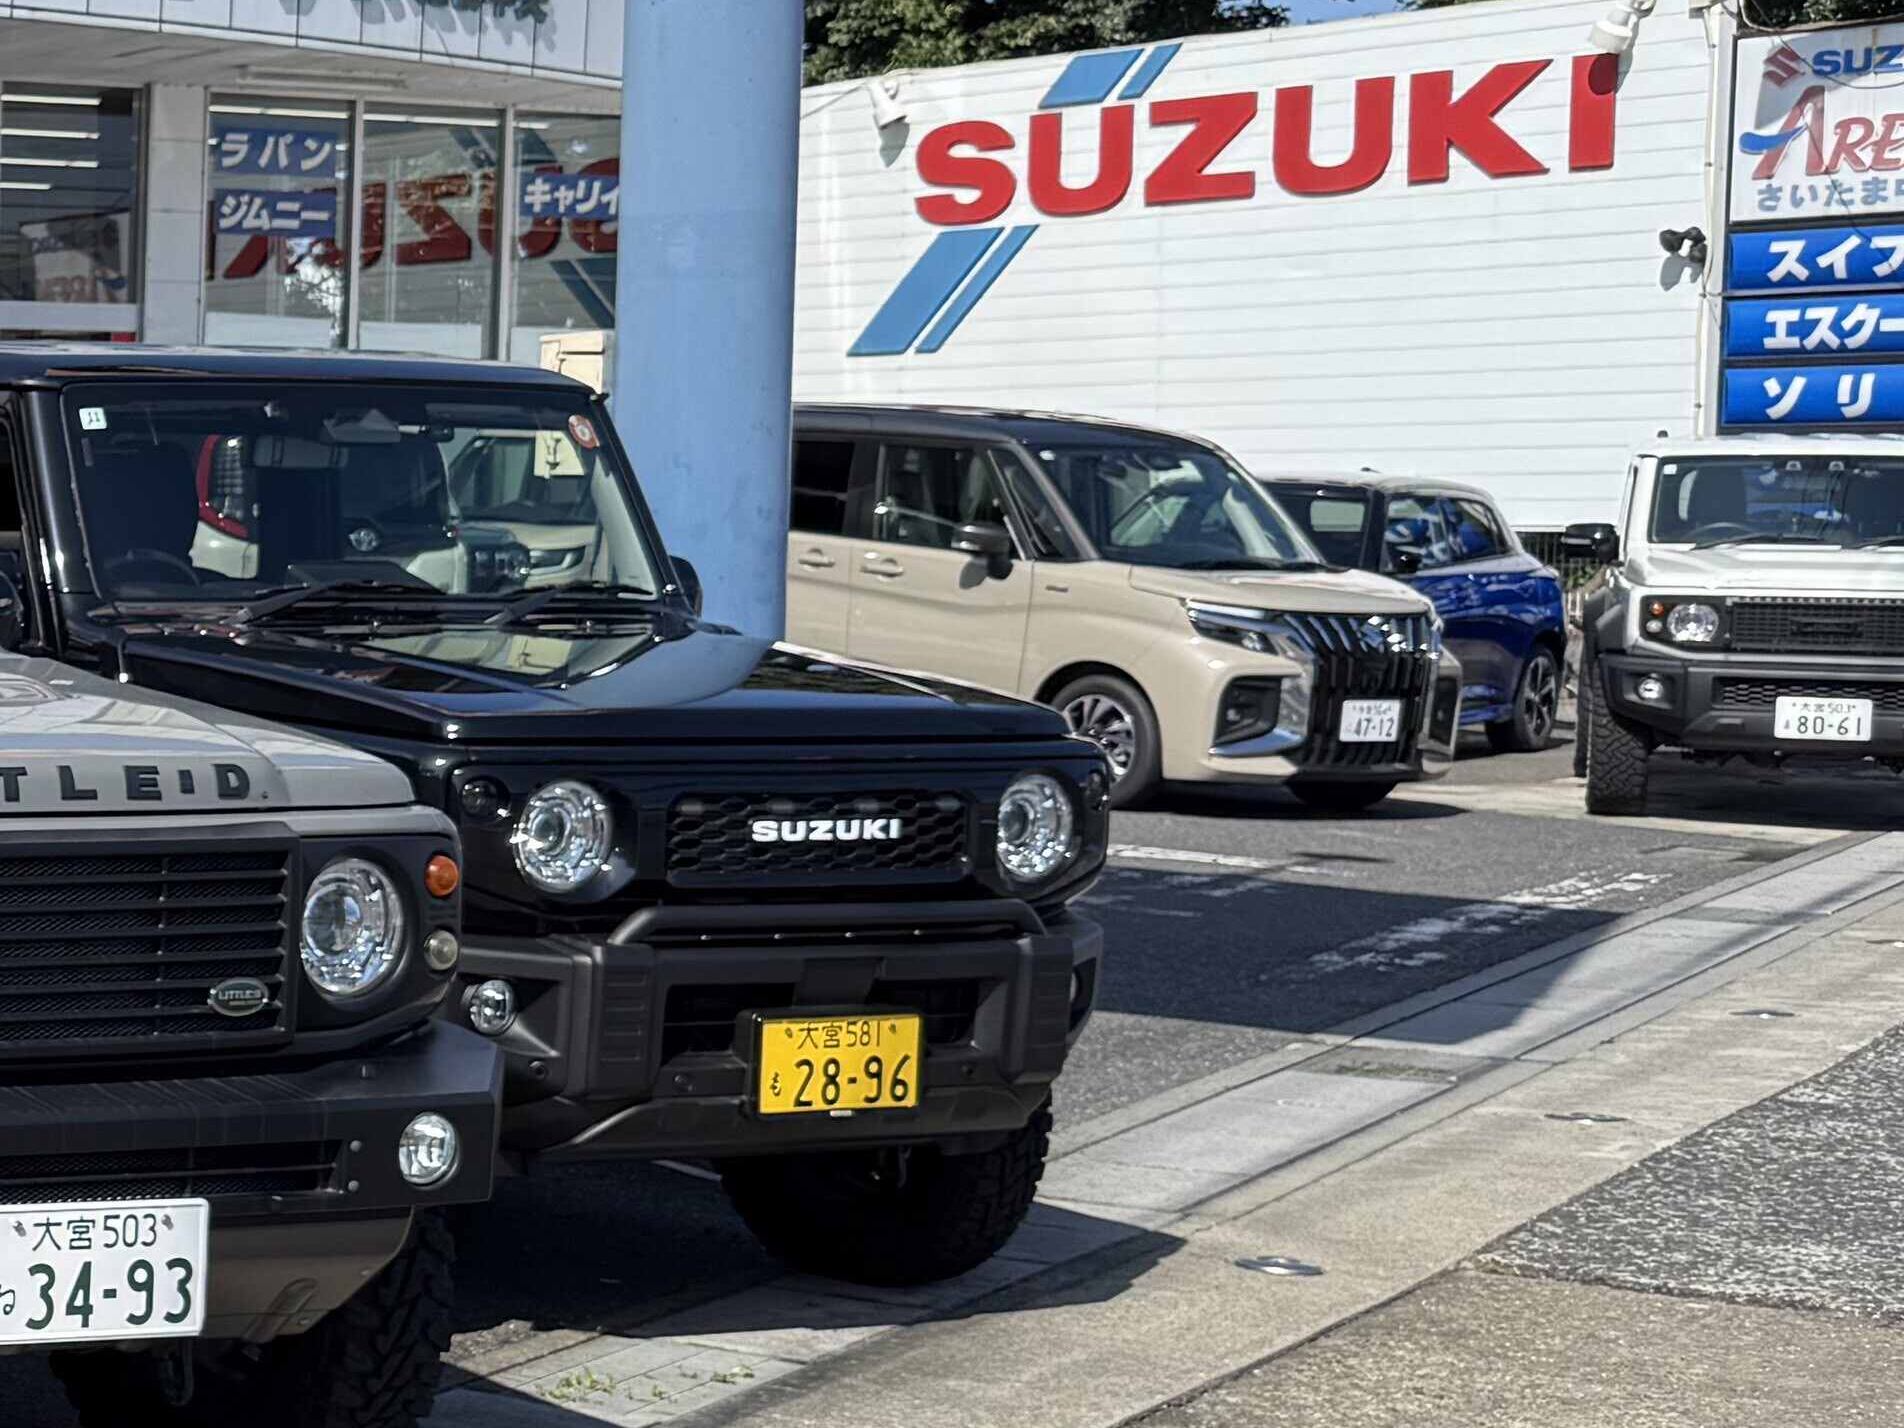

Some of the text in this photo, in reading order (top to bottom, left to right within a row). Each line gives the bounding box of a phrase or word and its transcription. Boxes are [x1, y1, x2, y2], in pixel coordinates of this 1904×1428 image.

[220, 133, 336, 171] ラパン
[914, 52, 1617, 227] SUZUKI
[217, 194, 331, 231] ジムニー
[750, 818, 901, 843] SUZUKI
[793, 1053, 911, 1108] 28-96
[24, 1256, 194, 1331] 34-93
